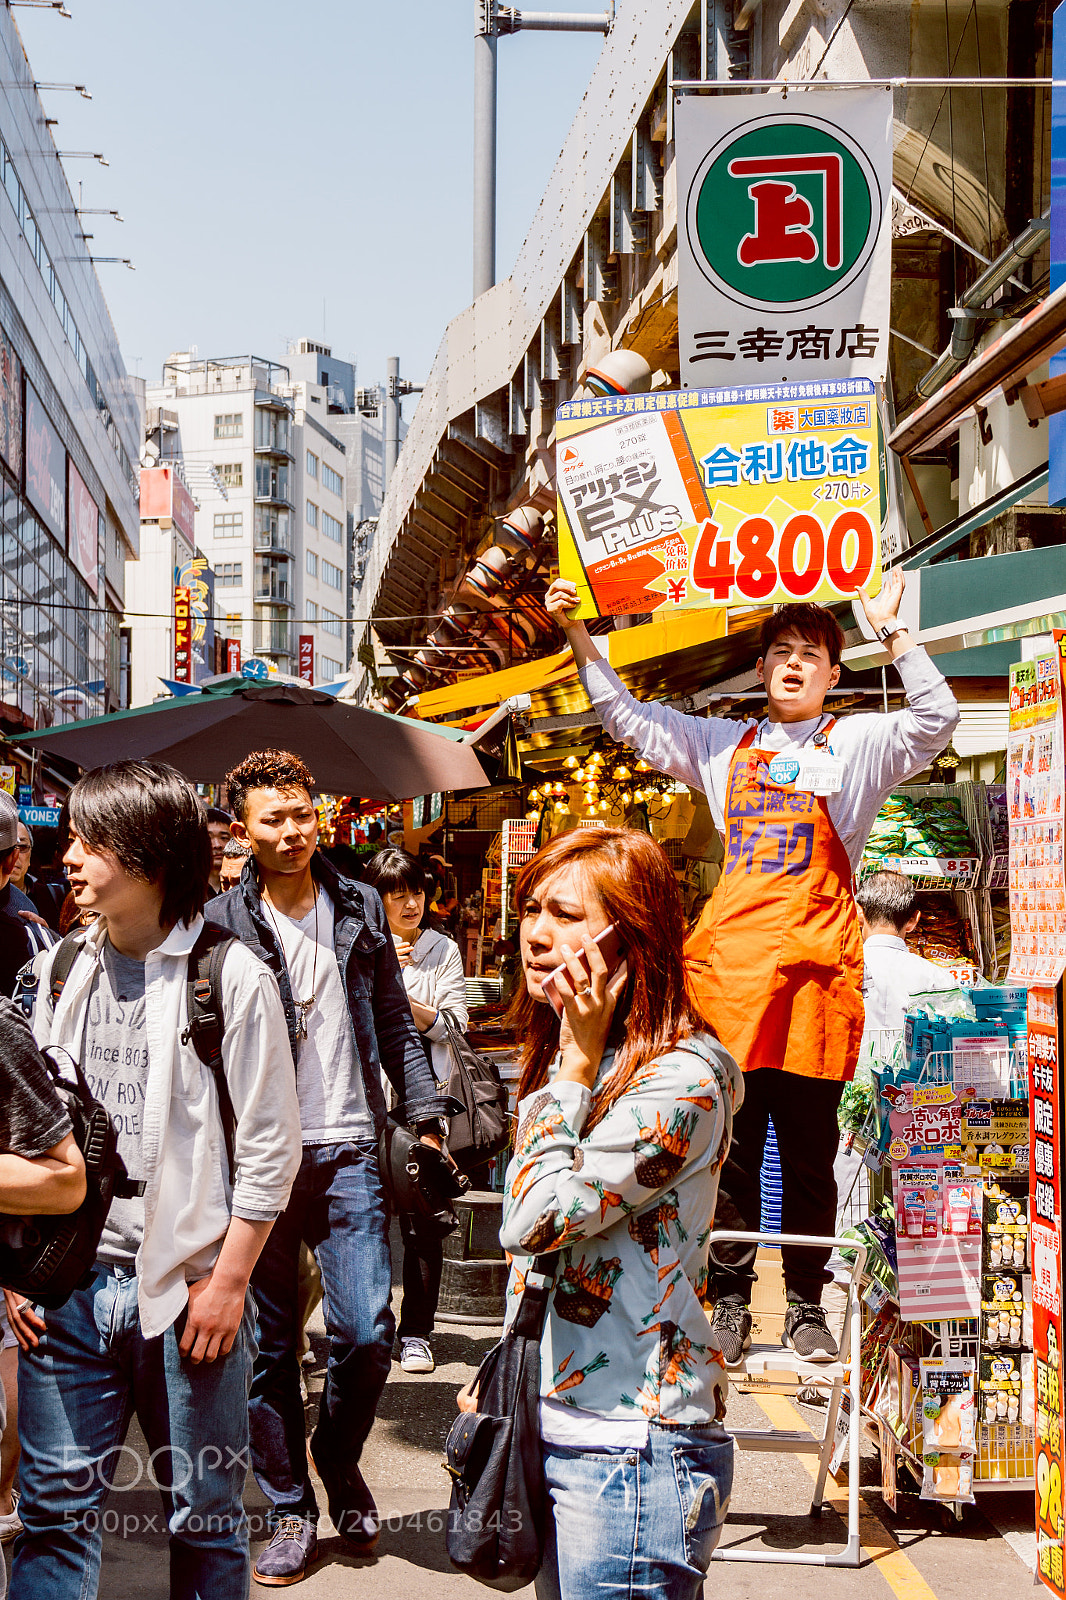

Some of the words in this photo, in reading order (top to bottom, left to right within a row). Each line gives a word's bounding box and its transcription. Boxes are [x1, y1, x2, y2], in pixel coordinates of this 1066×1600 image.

[689, 324, 880, 363] 三幸商店
[704, 436, 869, 485] 合利他命
[569, 460, 658, 509] アリナミン
[601, 504, 683, 555] PLUS
[692, 510, 875, 600] 4800
[174, 588, 189, 647] スロット
[770, 762, 798, 774] ENGLISH
[775, 772, 791, 782] OK
[24, 809, 60, 823] YONEX
[725, 818, 815, 877] ダイコク
[947, 860, 969, 871] 85
[904, 1121, 960, 1143] ポロポ
[914, 1107, 961, 1124] 古い角質
